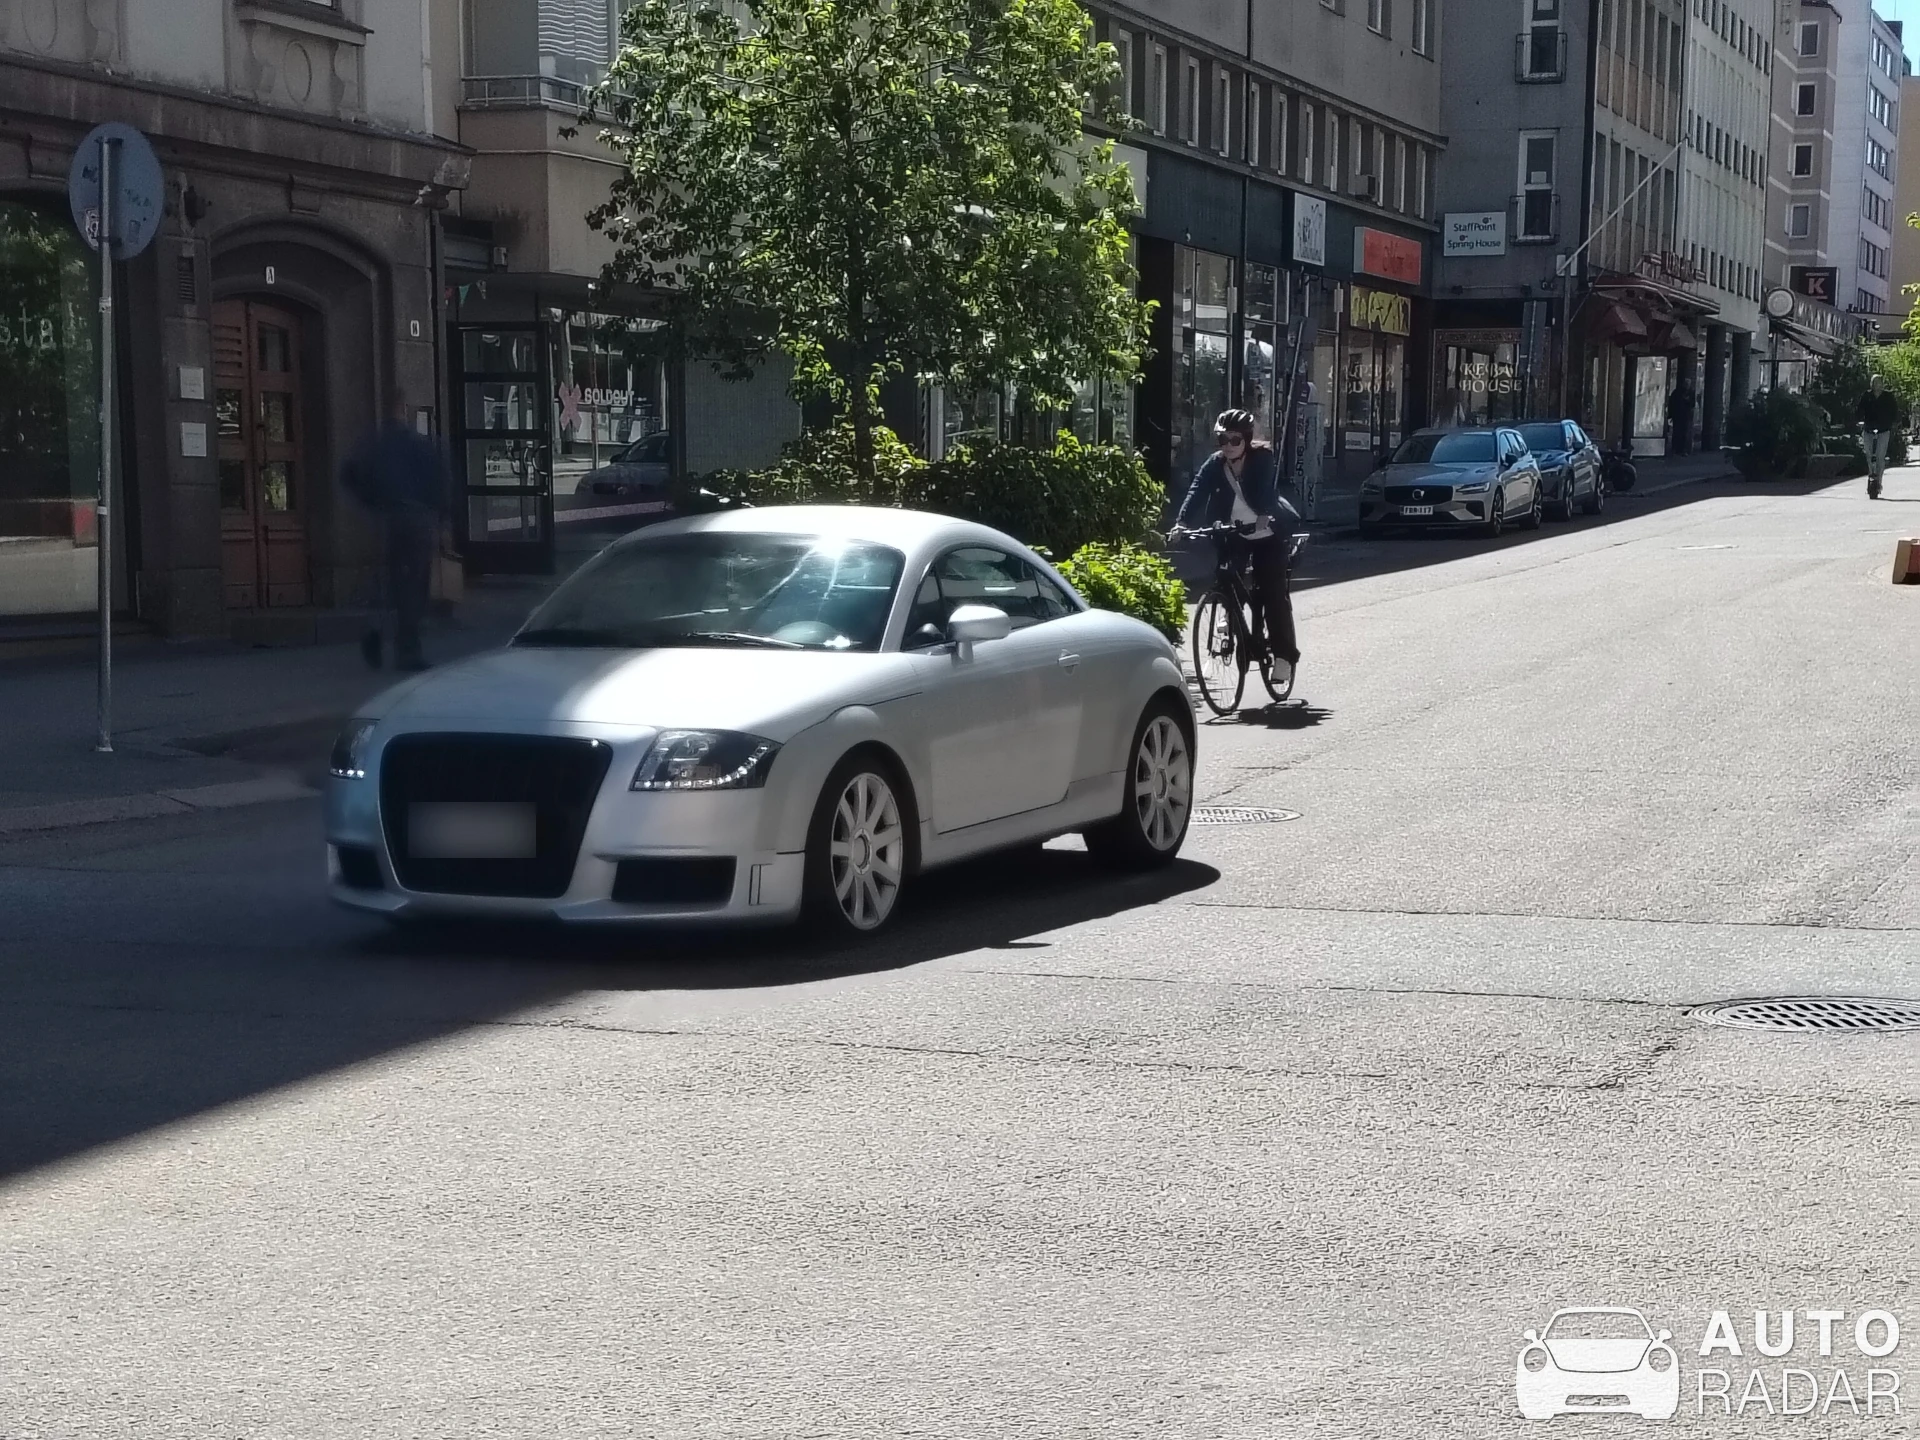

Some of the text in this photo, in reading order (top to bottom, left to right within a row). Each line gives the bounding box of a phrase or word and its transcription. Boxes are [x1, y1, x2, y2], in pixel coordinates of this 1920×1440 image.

[1453, 222, 1497, 232] StaffPoint
[1447, 240, 1501, 250] Spring House
[1462, 379, 1522, 394] HOUSE
